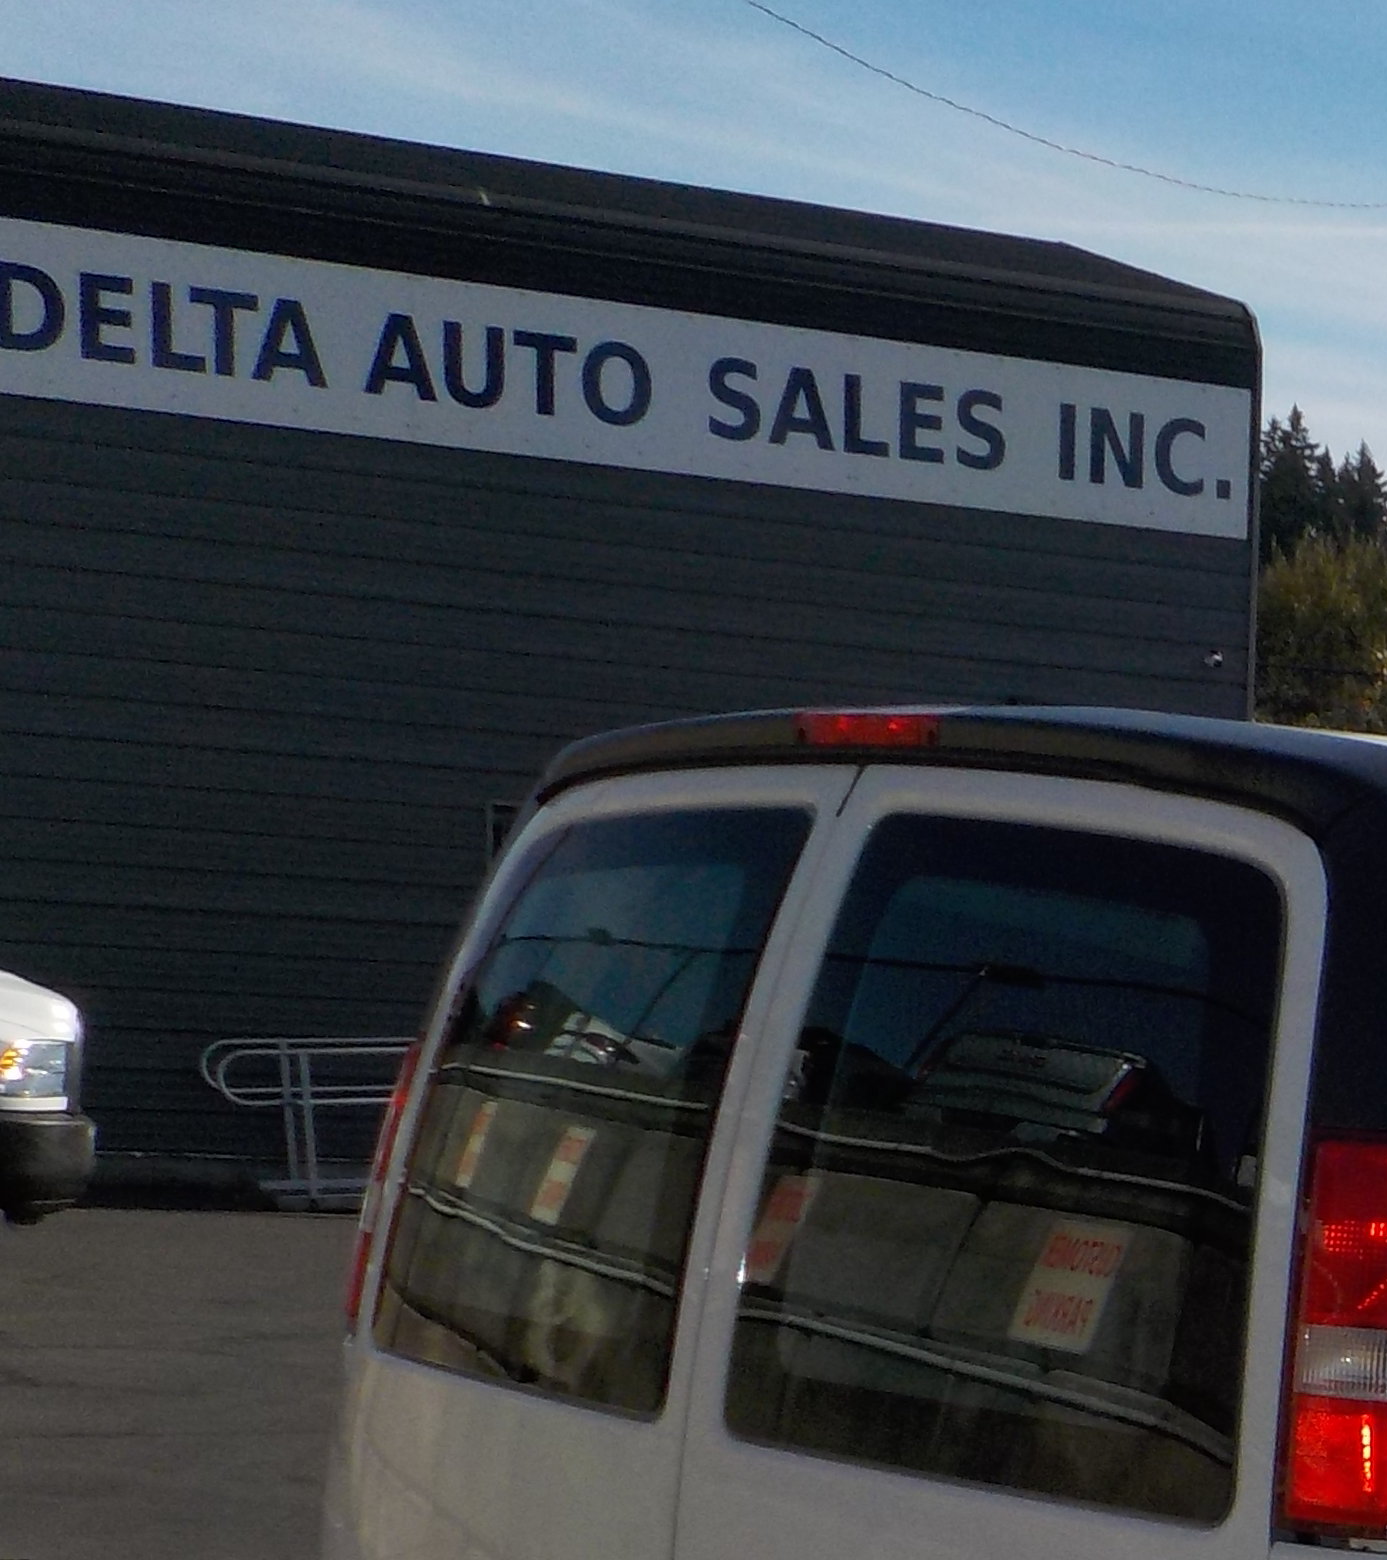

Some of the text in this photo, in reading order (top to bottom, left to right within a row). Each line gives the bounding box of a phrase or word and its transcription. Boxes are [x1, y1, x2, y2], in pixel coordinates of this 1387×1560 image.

[0, 260, 1232, 500] DELTA AUTO SALES INC.
